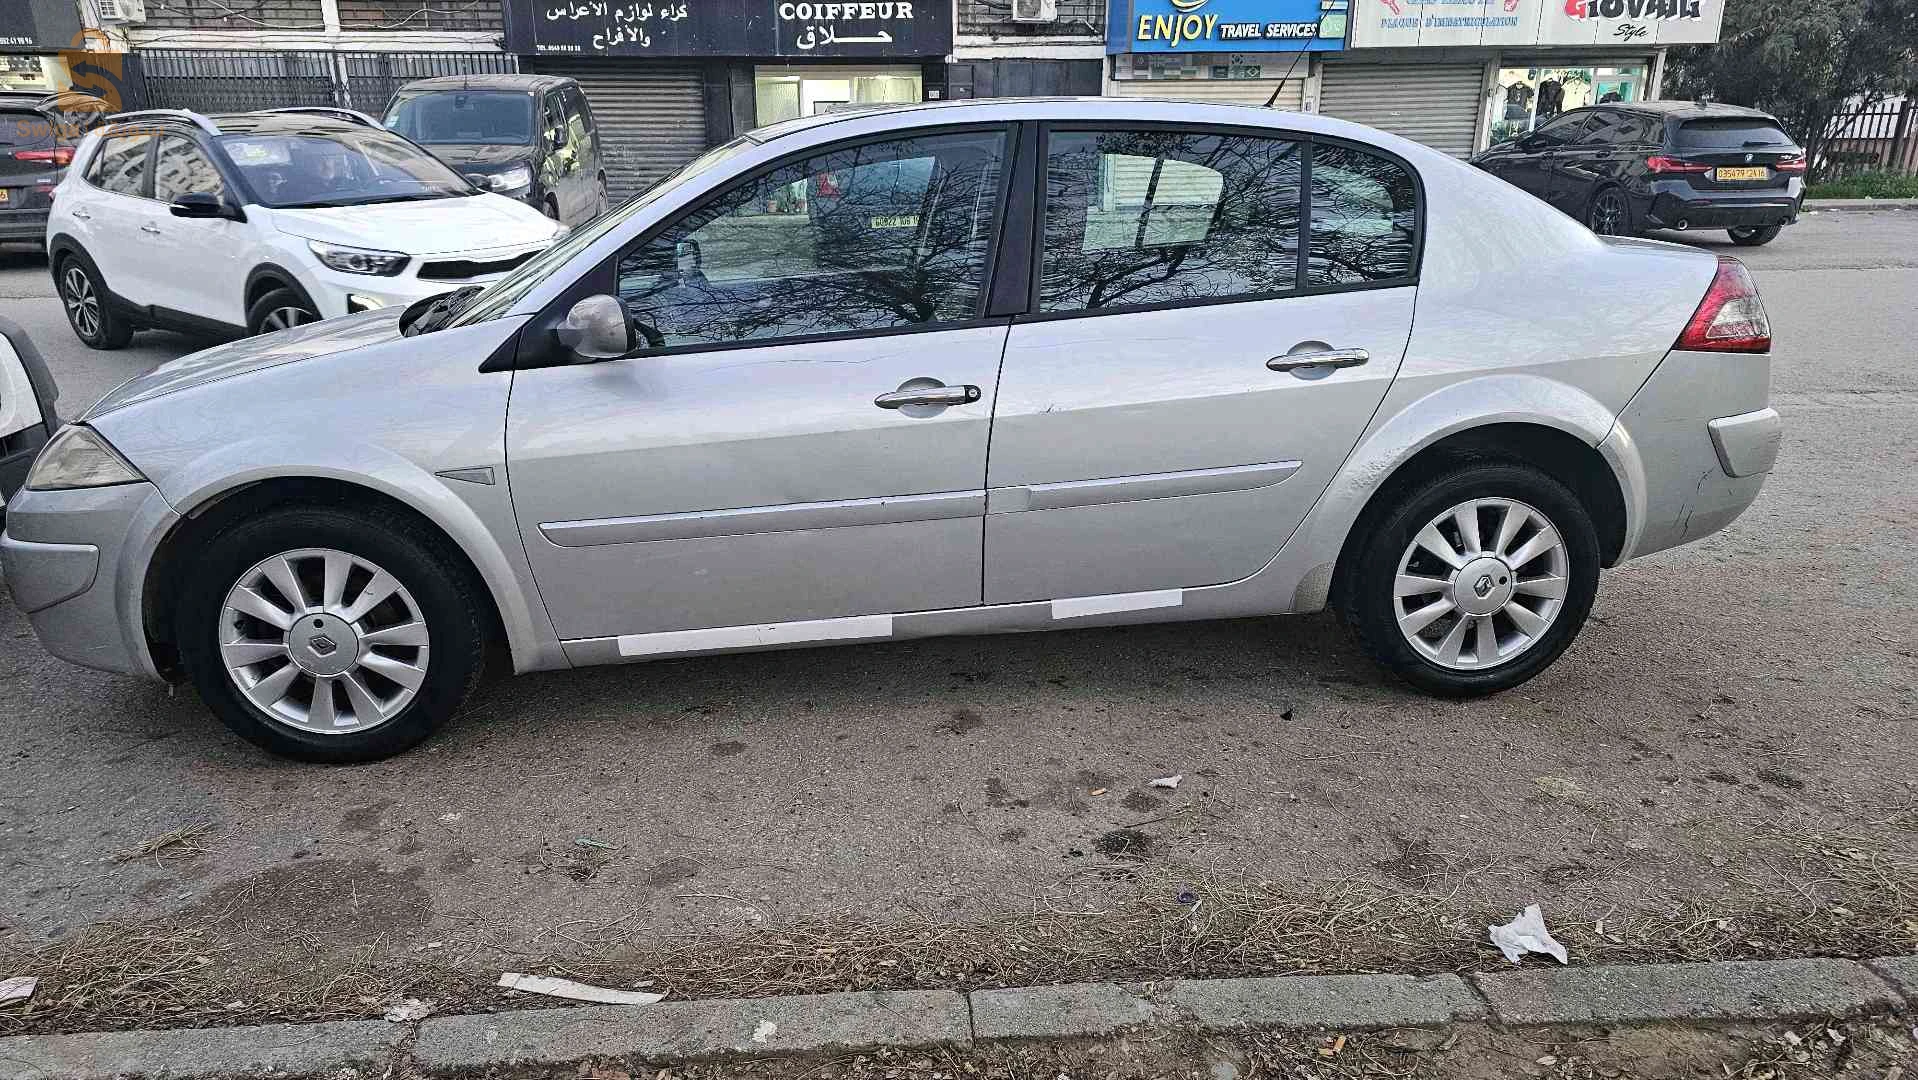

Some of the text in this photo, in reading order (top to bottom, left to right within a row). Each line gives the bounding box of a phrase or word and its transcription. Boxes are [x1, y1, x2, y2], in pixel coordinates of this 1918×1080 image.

[614, 2, 653, 23] لوازم
[660, 3, 688, 21] كراء
[779, 1, 914, 20] COIFFEUR
[1137, 14, 1318, 47] ENJOY TRAVEL SERVICES
[1613, 23, 1649, 42] Style
